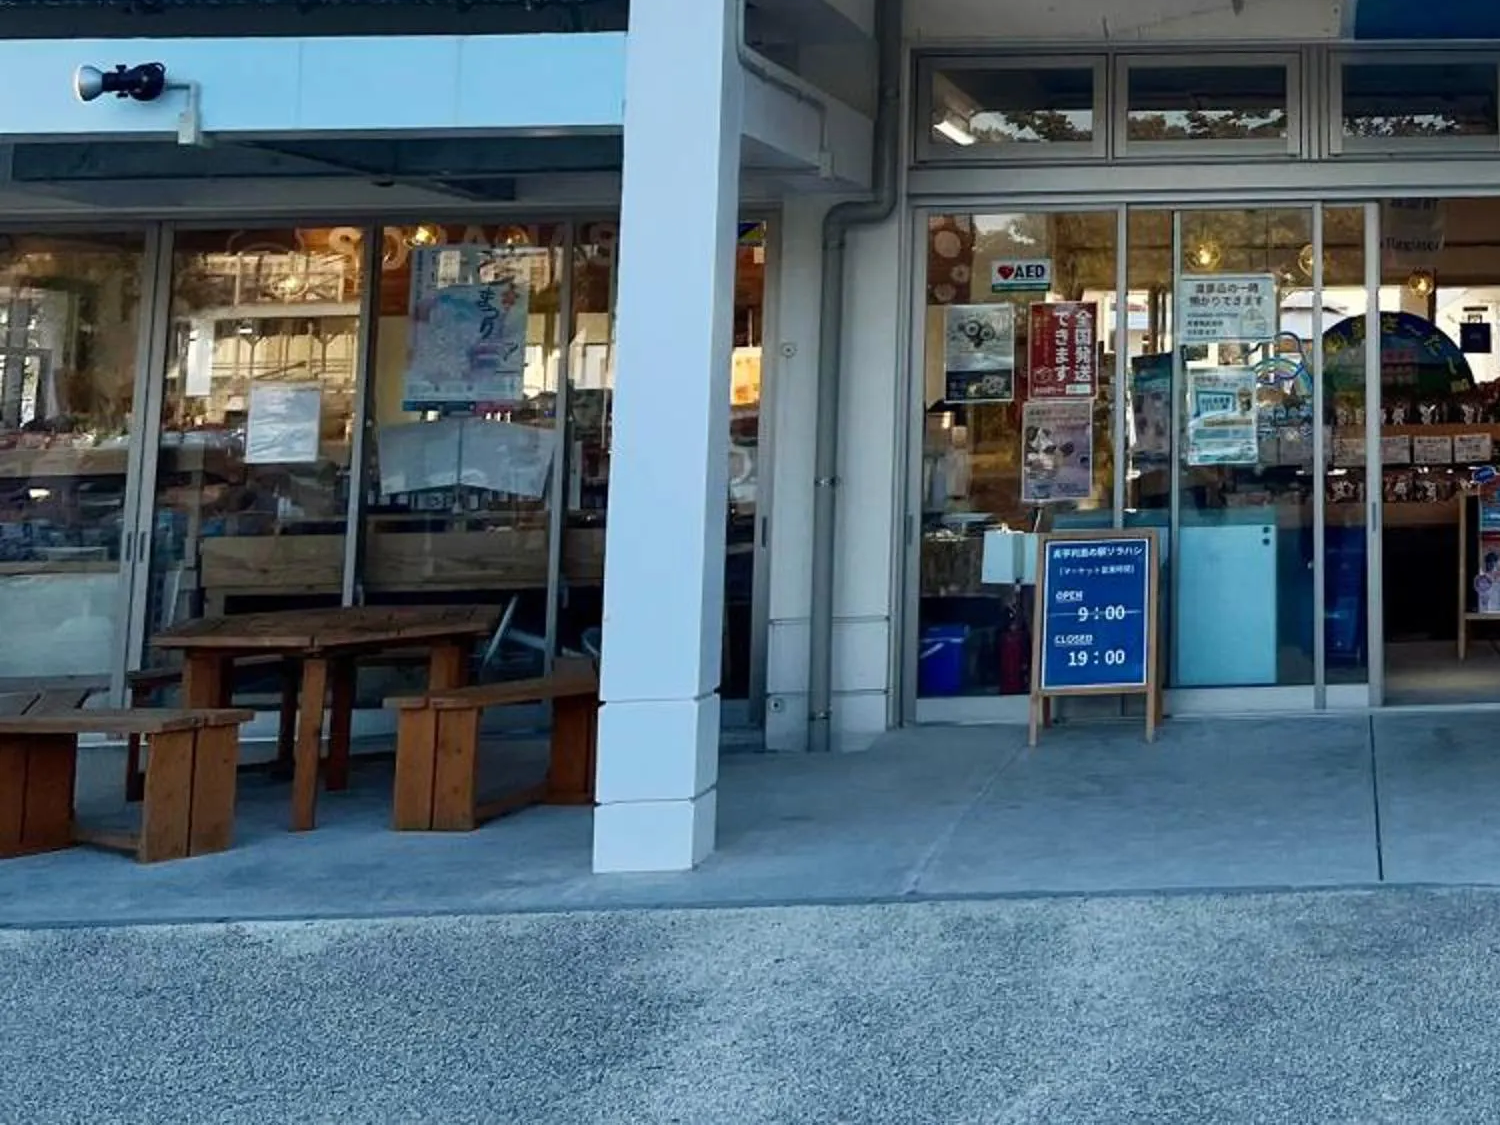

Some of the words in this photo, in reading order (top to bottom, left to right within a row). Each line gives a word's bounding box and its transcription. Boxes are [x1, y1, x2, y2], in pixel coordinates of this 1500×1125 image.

[1014, 264, 1045, 279] AED
[1053, 311, 1070, 382] できます
[1075, 310, 1092, 382] 全国発送
[1056, 591, 1083, 602] OPEN
[1054, 634, 1092, 646] CLOSED
